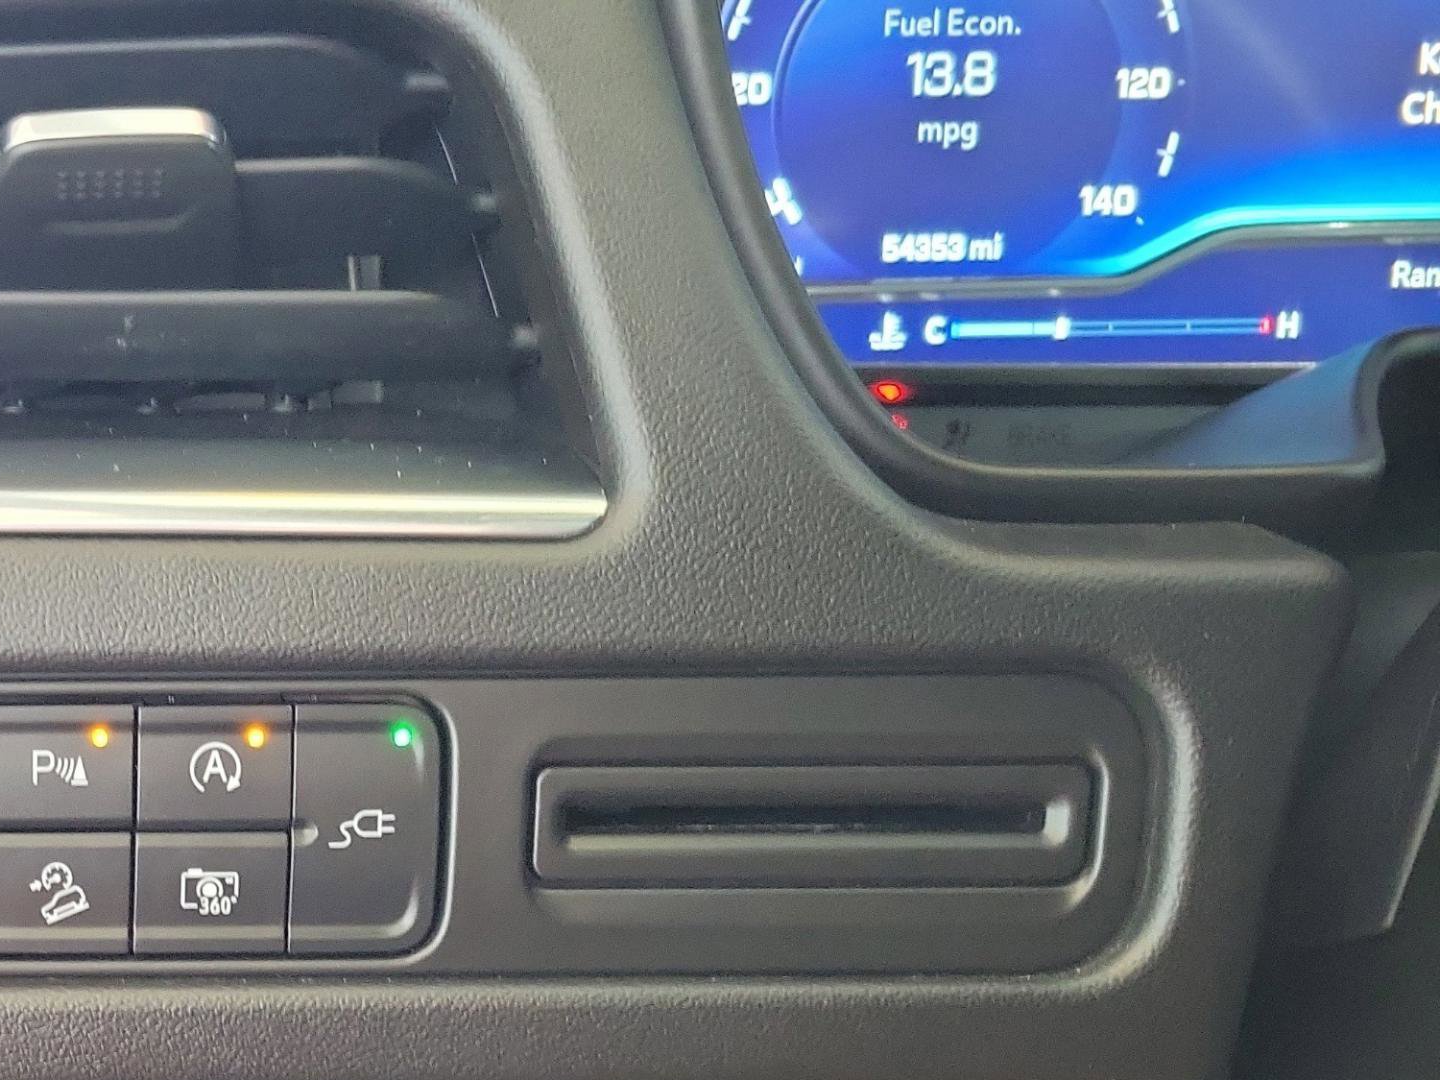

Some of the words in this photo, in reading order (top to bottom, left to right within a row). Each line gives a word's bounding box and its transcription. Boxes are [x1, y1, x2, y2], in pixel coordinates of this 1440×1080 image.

[884, 8, 939, 36] Fuel
[947, 8, 1021, 36] Econ.
[906, 50, 996, 97] 13.8
[1117, 68, 1172, 98] 120
[917, 121, 978, 150] mpg
[1079, 185, 1137, 216] 140
[881, 232, 966, 263] 54353
[969, 231, 1003, 261] mi
[924, 315, 948, 345] C
[1276, 310, 1301, 339] H
[32, 749, 54, 786] P
[203, 750, 227, 783] A
